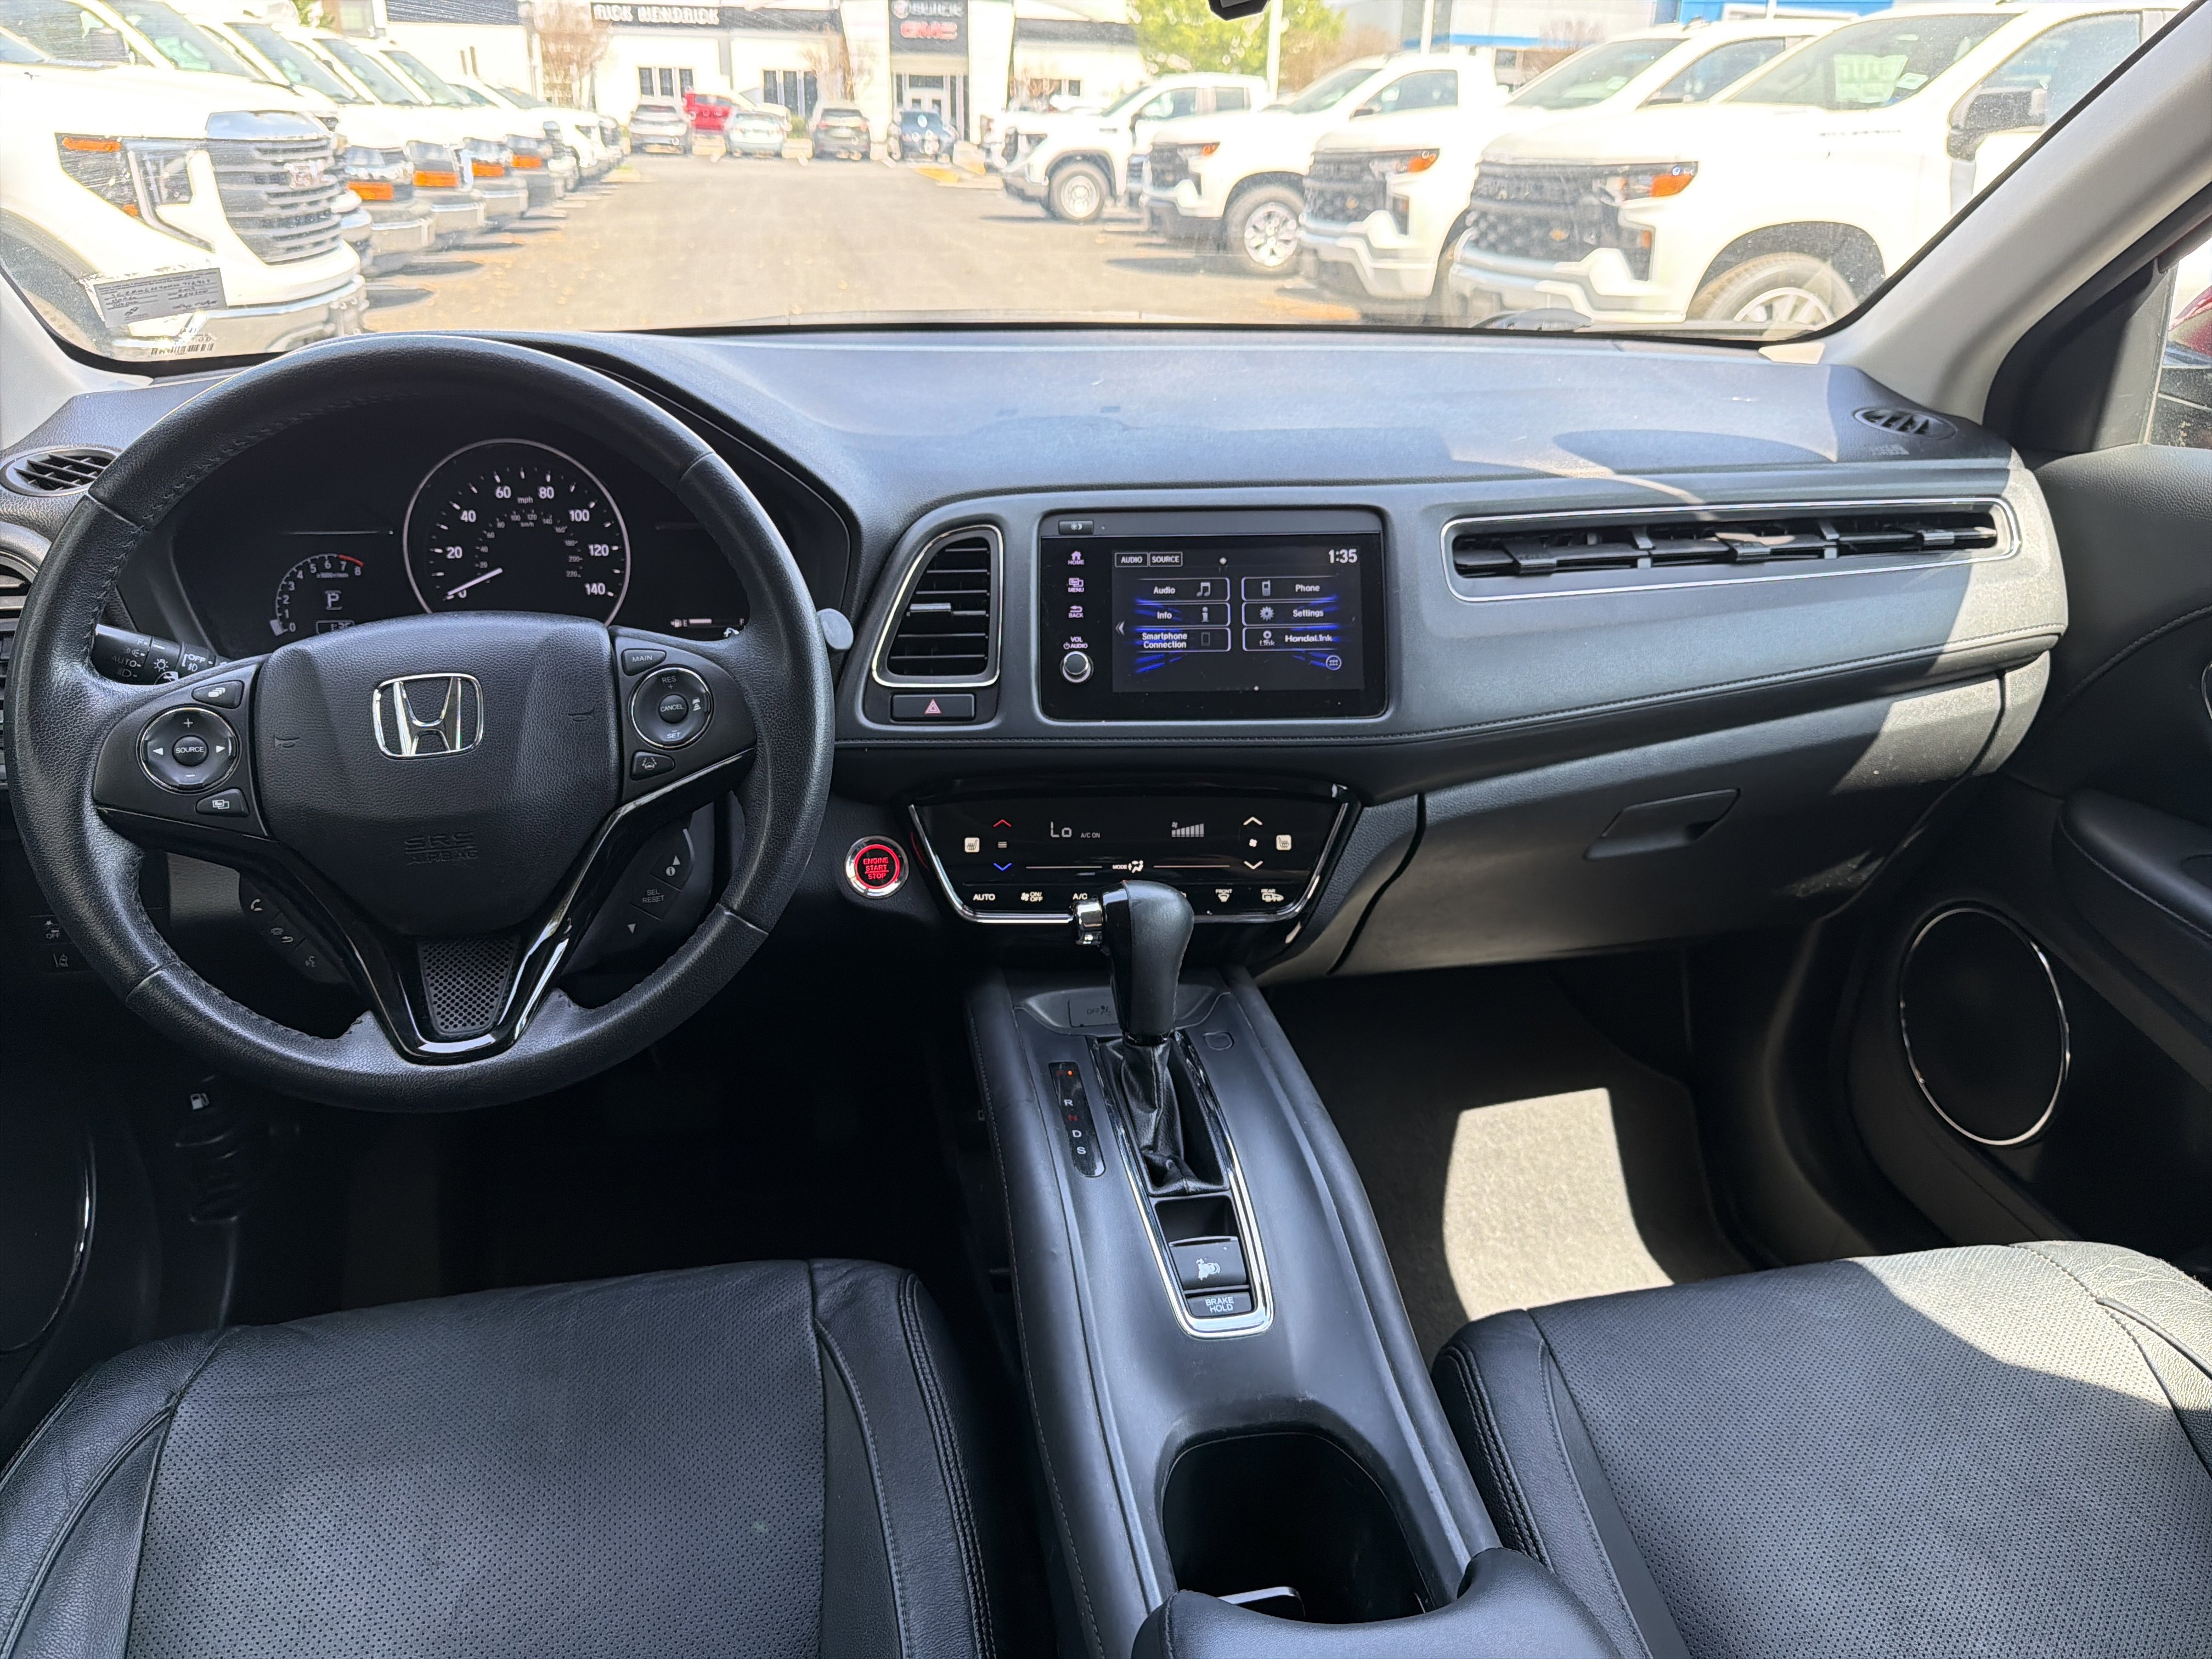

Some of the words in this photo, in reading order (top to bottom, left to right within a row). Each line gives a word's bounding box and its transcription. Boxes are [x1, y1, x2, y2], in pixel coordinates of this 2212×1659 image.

[593, 4, 633, 22] RICK
[637, 6, 719, 25] HENDRICK
[495, 486, 511, 499] 60
[538, 486, 555, 499] 80
[517, 496, 533, 504] mph
[460, 510, 476, 522] 40
[569, 509, 590, 522] 100
[446, 546, 462, 558] 20
[589, 544, 609, 557] 120
[1328, 549, 1358, 564] 1:35
[310, 563, 317, 573] 5
[324, 560, 331, 569] 6
[340, 561, 347, 571] 7
[297, 571, 303, 579] 4
[354, 566, 361, 576] 8
[289, 582, 295, 591] 3
[584, 582, 605, 595] 140
[283, 595, 290, 604] 2
[328, 593, 339, 608] P
[285, 609, 289, 618] 1
[1293, 610, 1324, 618] Settings
[289, 622, 296, 632] 0
[683, 619, 688, 627] E
[1142, 632, 1188, 640] Smartphone
[1285, 634, 1333, 642] HondaLink
[188, 654, 206, 664] OFF
[660, 704, 684, 712] CANCEL
[175, 746, 205, 754] SOURCE
[1051, 821, 1072, 838] Lo
[863, 857, 889, 865] ENGINE
[642, 895, 665, 903] RESET
[1072, 1130, 1082, 1138] D
[1076, 1147, 1086, 1155] S
[1205, 1296, 1234, 1306] BRAKE
[1210, 1304, 1233, 1313] HOLD
